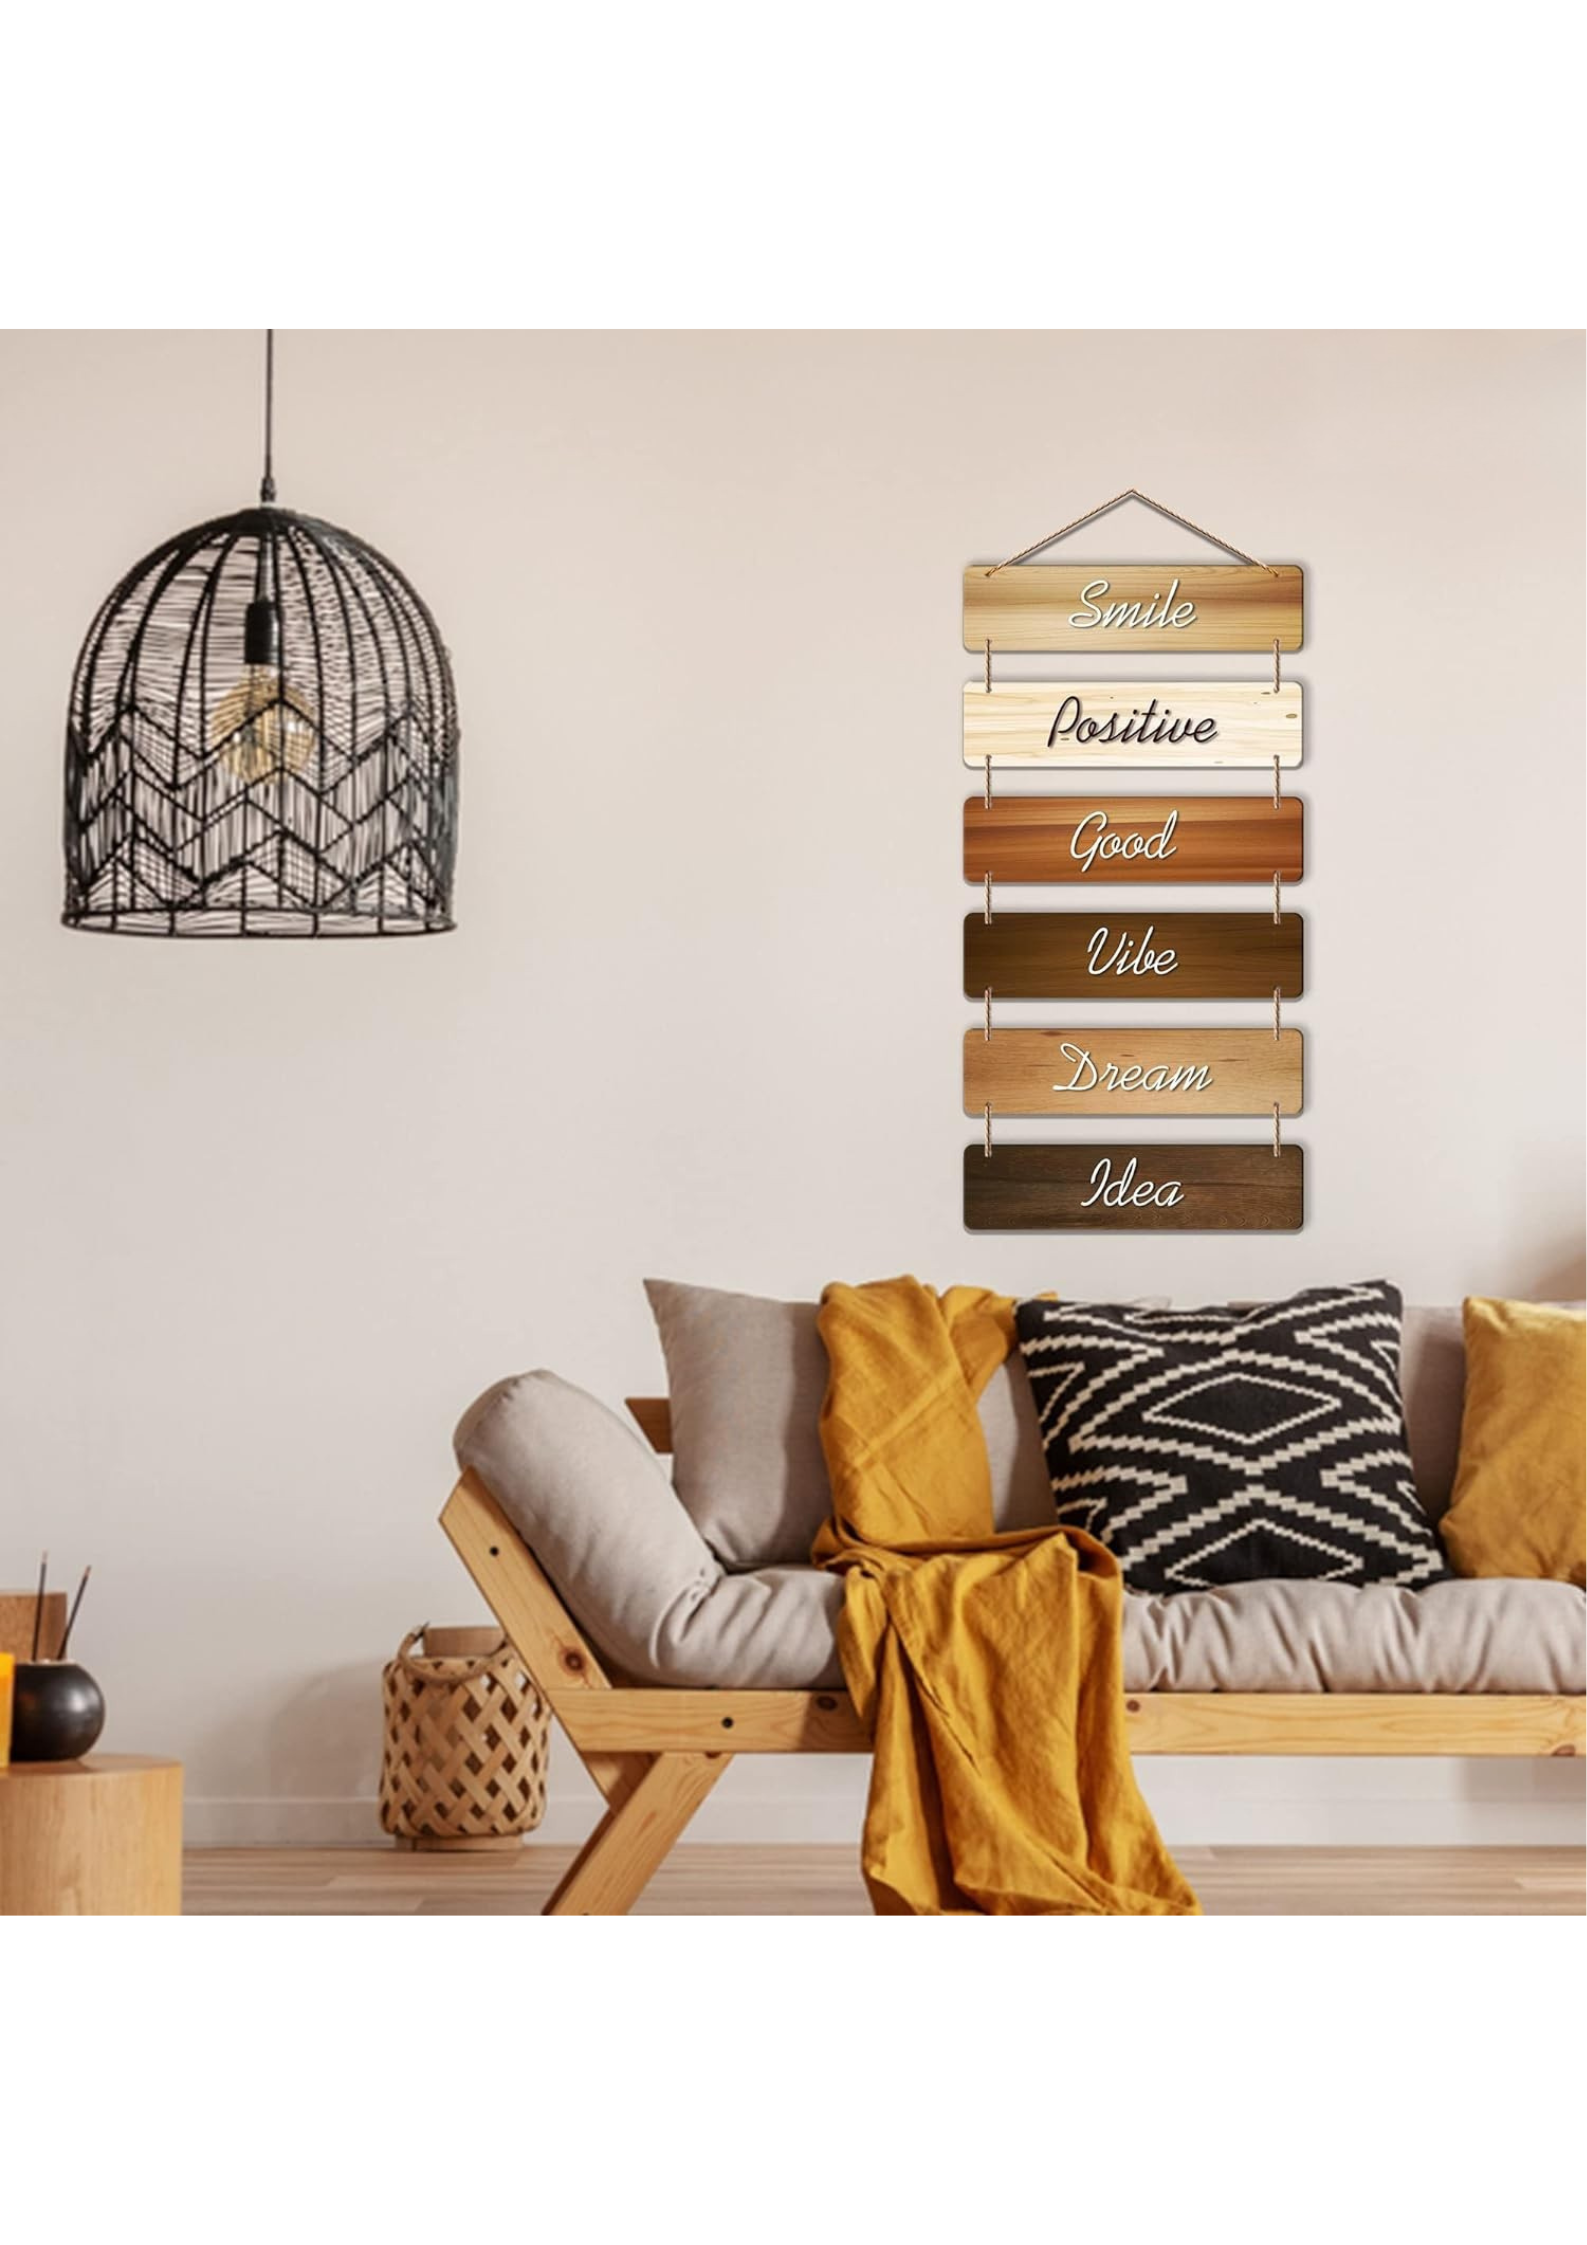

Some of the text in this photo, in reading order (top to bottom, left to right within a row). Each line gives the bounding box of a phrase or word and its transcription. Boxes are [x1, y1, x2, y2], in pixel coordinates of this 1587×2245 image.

[1068, 579, 1197, 628] Smile
[1047, 696, 1219, 748] Positive
[1069, 810, 1179, 873] Good
[1087, 926, 1179, 975] Vibe
[1052, 1042, 1213, 1092] Dream
[1080, 1157, 1185, 1208] Idea
